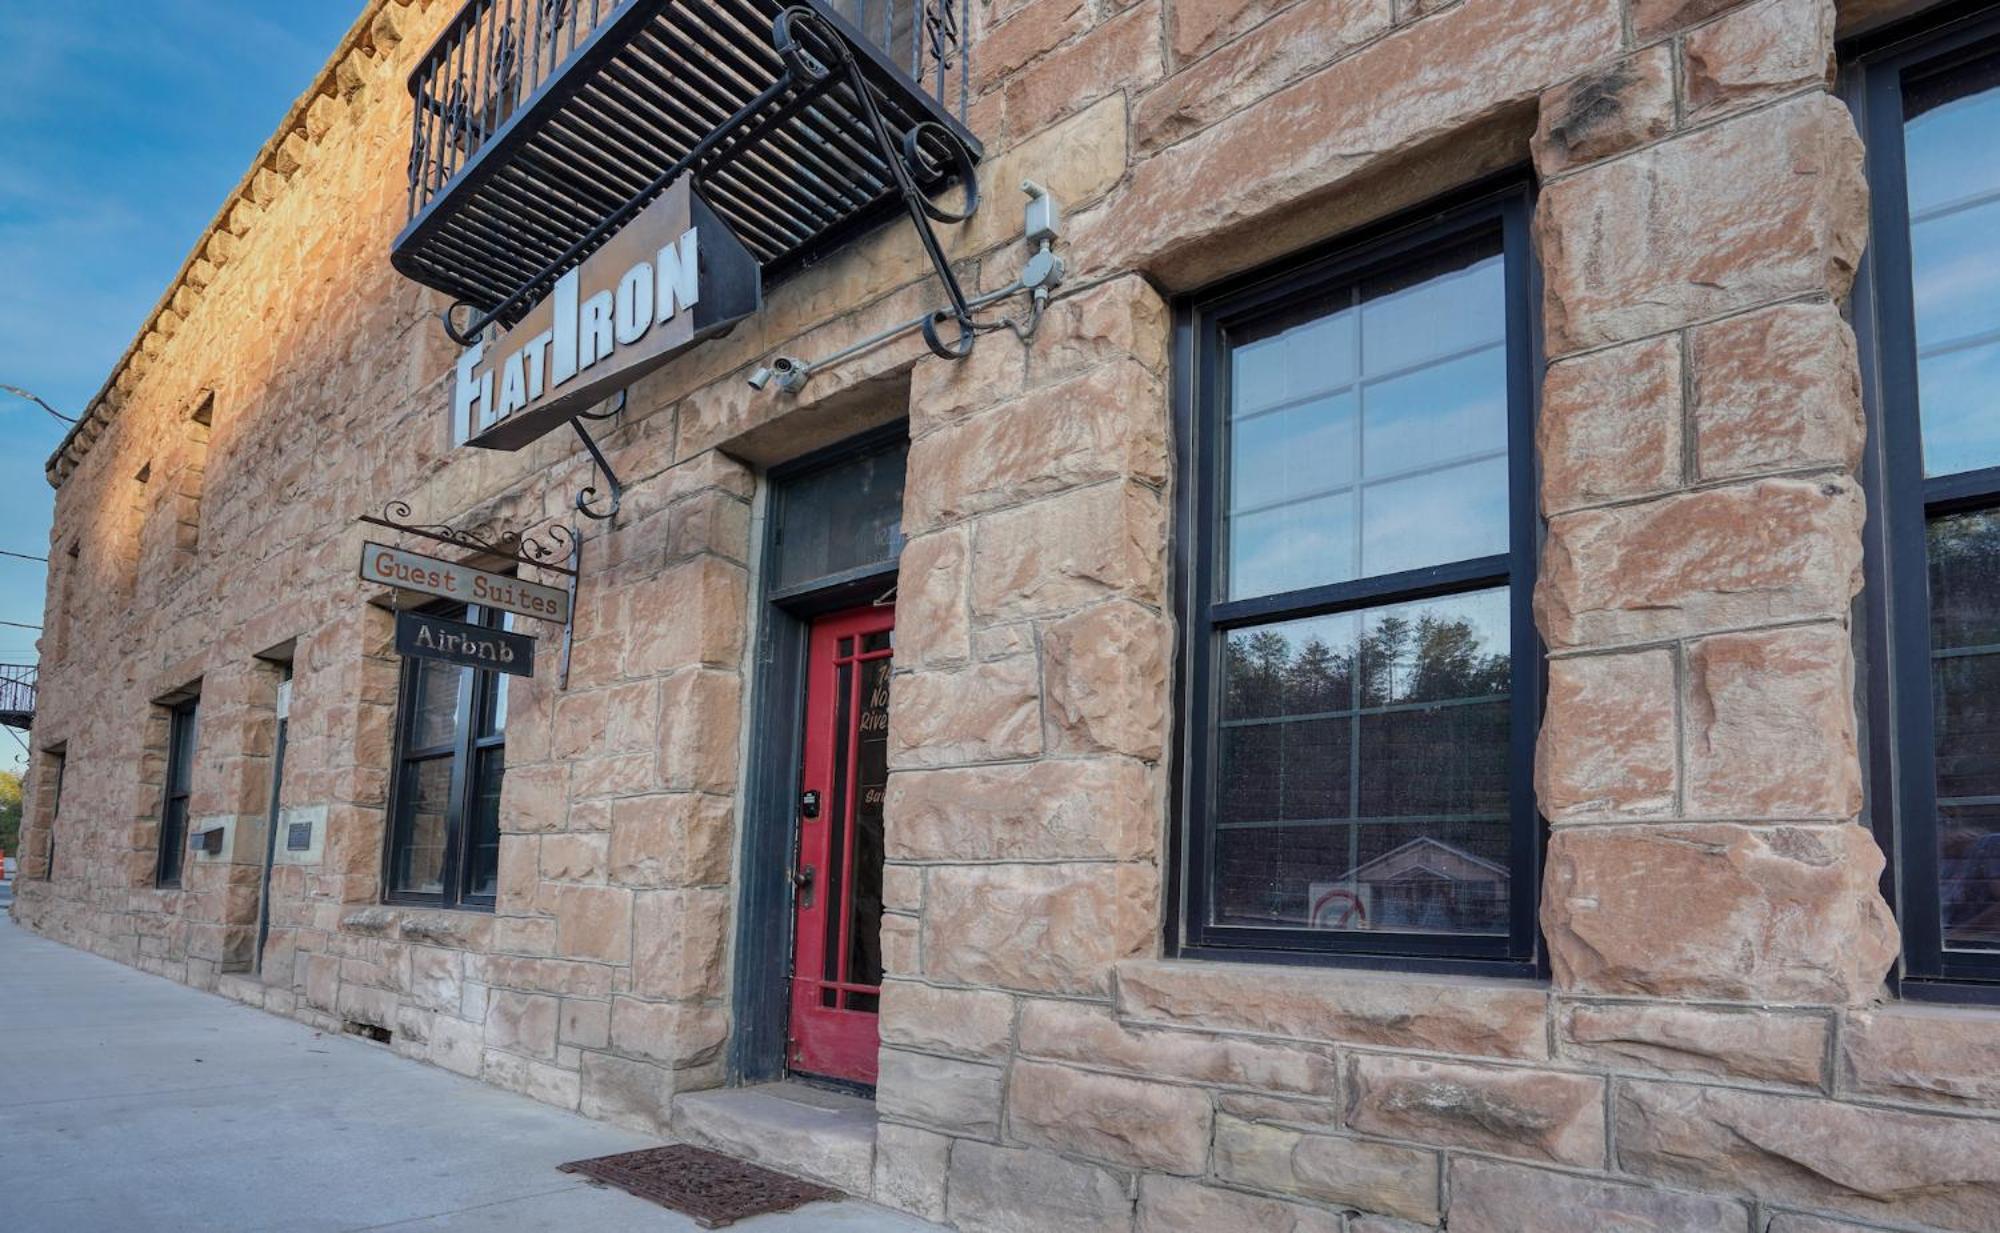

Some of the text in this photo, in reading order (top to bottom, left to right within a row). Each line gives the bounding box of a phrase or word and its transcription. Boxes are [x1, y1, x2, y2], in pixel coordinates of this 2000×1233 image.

[375, 552, 557, 615] Guest Suites
[415, 624, 514, 663] Airbnb
[870, 687, 889, 708] No
[860, 711, 888, 731] Rive
